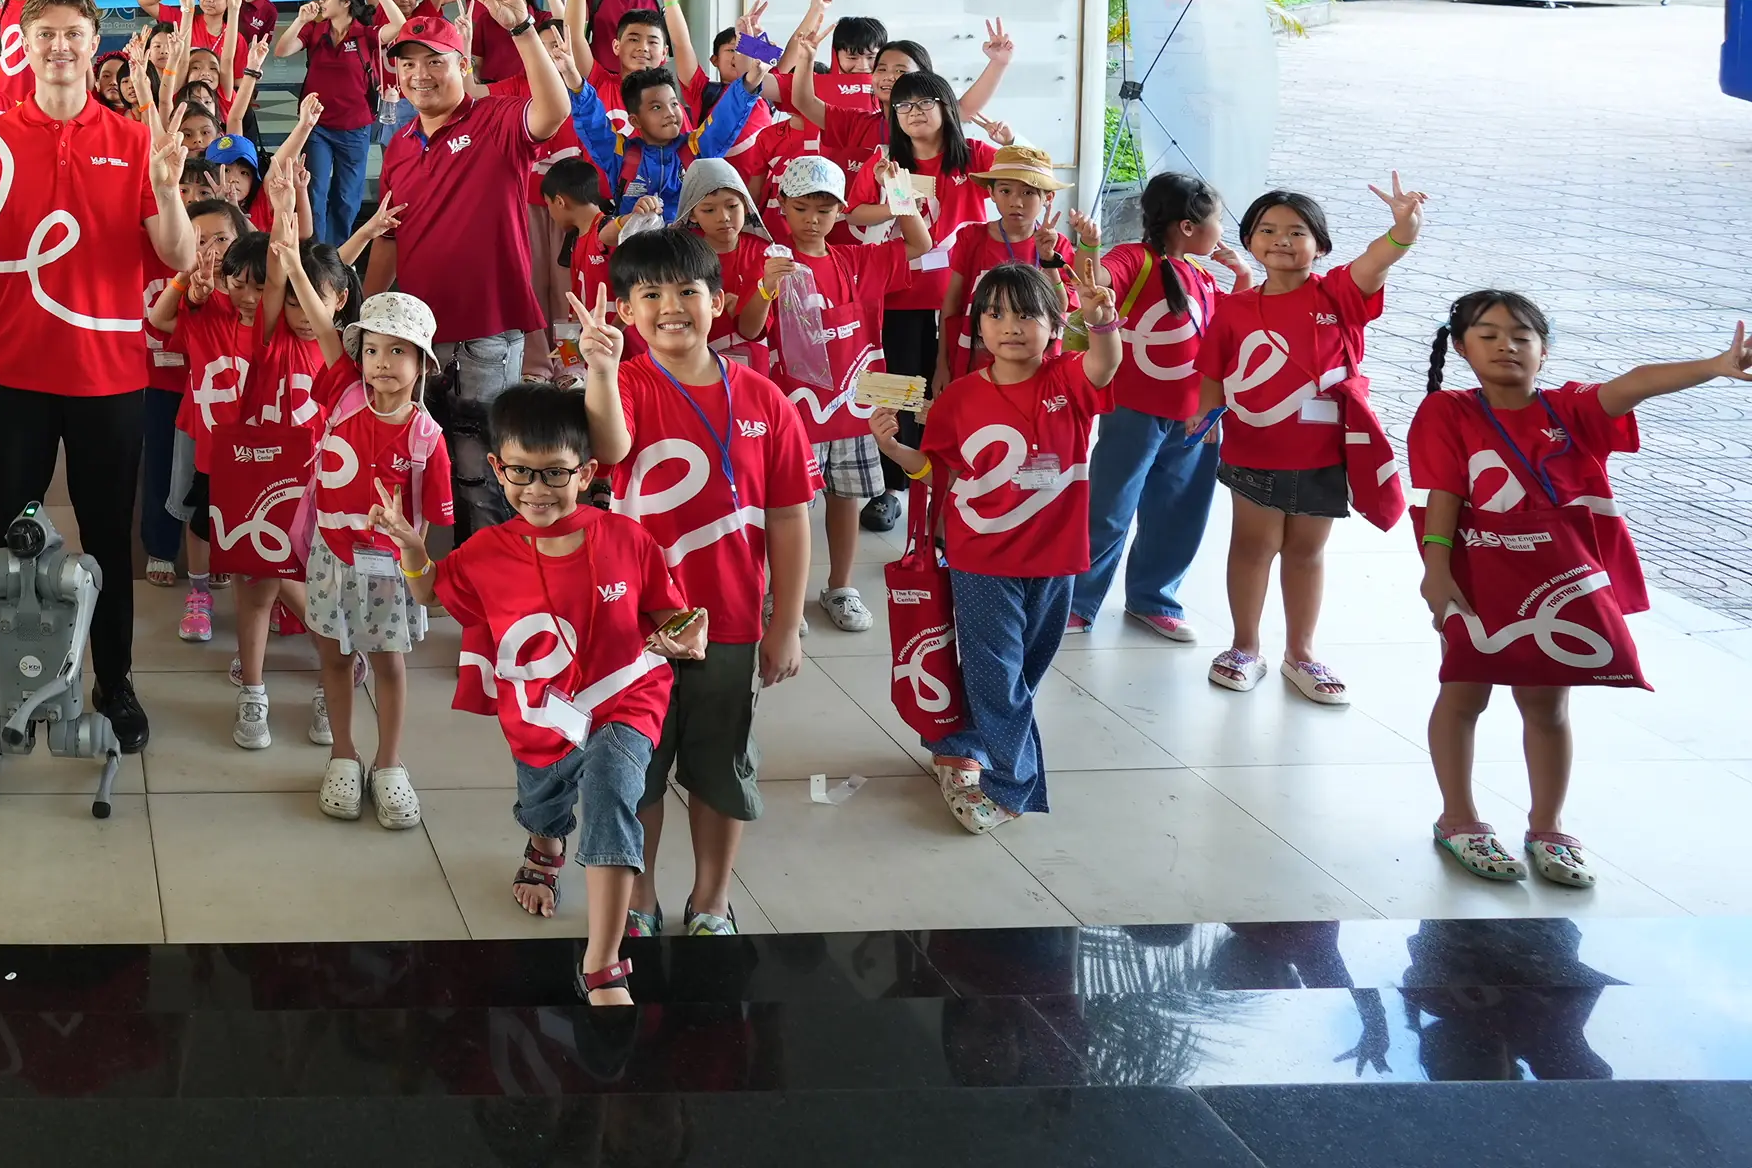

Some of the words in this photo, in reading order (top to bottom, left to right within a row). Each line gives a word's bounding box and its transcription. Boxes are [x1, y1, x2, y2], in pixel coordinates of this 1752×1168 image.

[838, 84, 861, 94] VUS
[447, 134, 471, 152] VUS
[588, 254, 605, 265] VUS
[1042, 394, 1068, 410] VUS
[735, 419, 768, 434] VUS
[233, 444, 253, 459] VUS
[1458, 528, 1501, 547] VUS
[1503, 535, 1517, 543] The
[1518, 534, 1548, 543] English
[597, 581, 627, 598] VUS
[1517, 582, 1551, 617] EMPOWERING
[1550, 564, 1592, 585] ASPIRATIONS,
[1547, 583, 1582, 609] TOGETHER!
